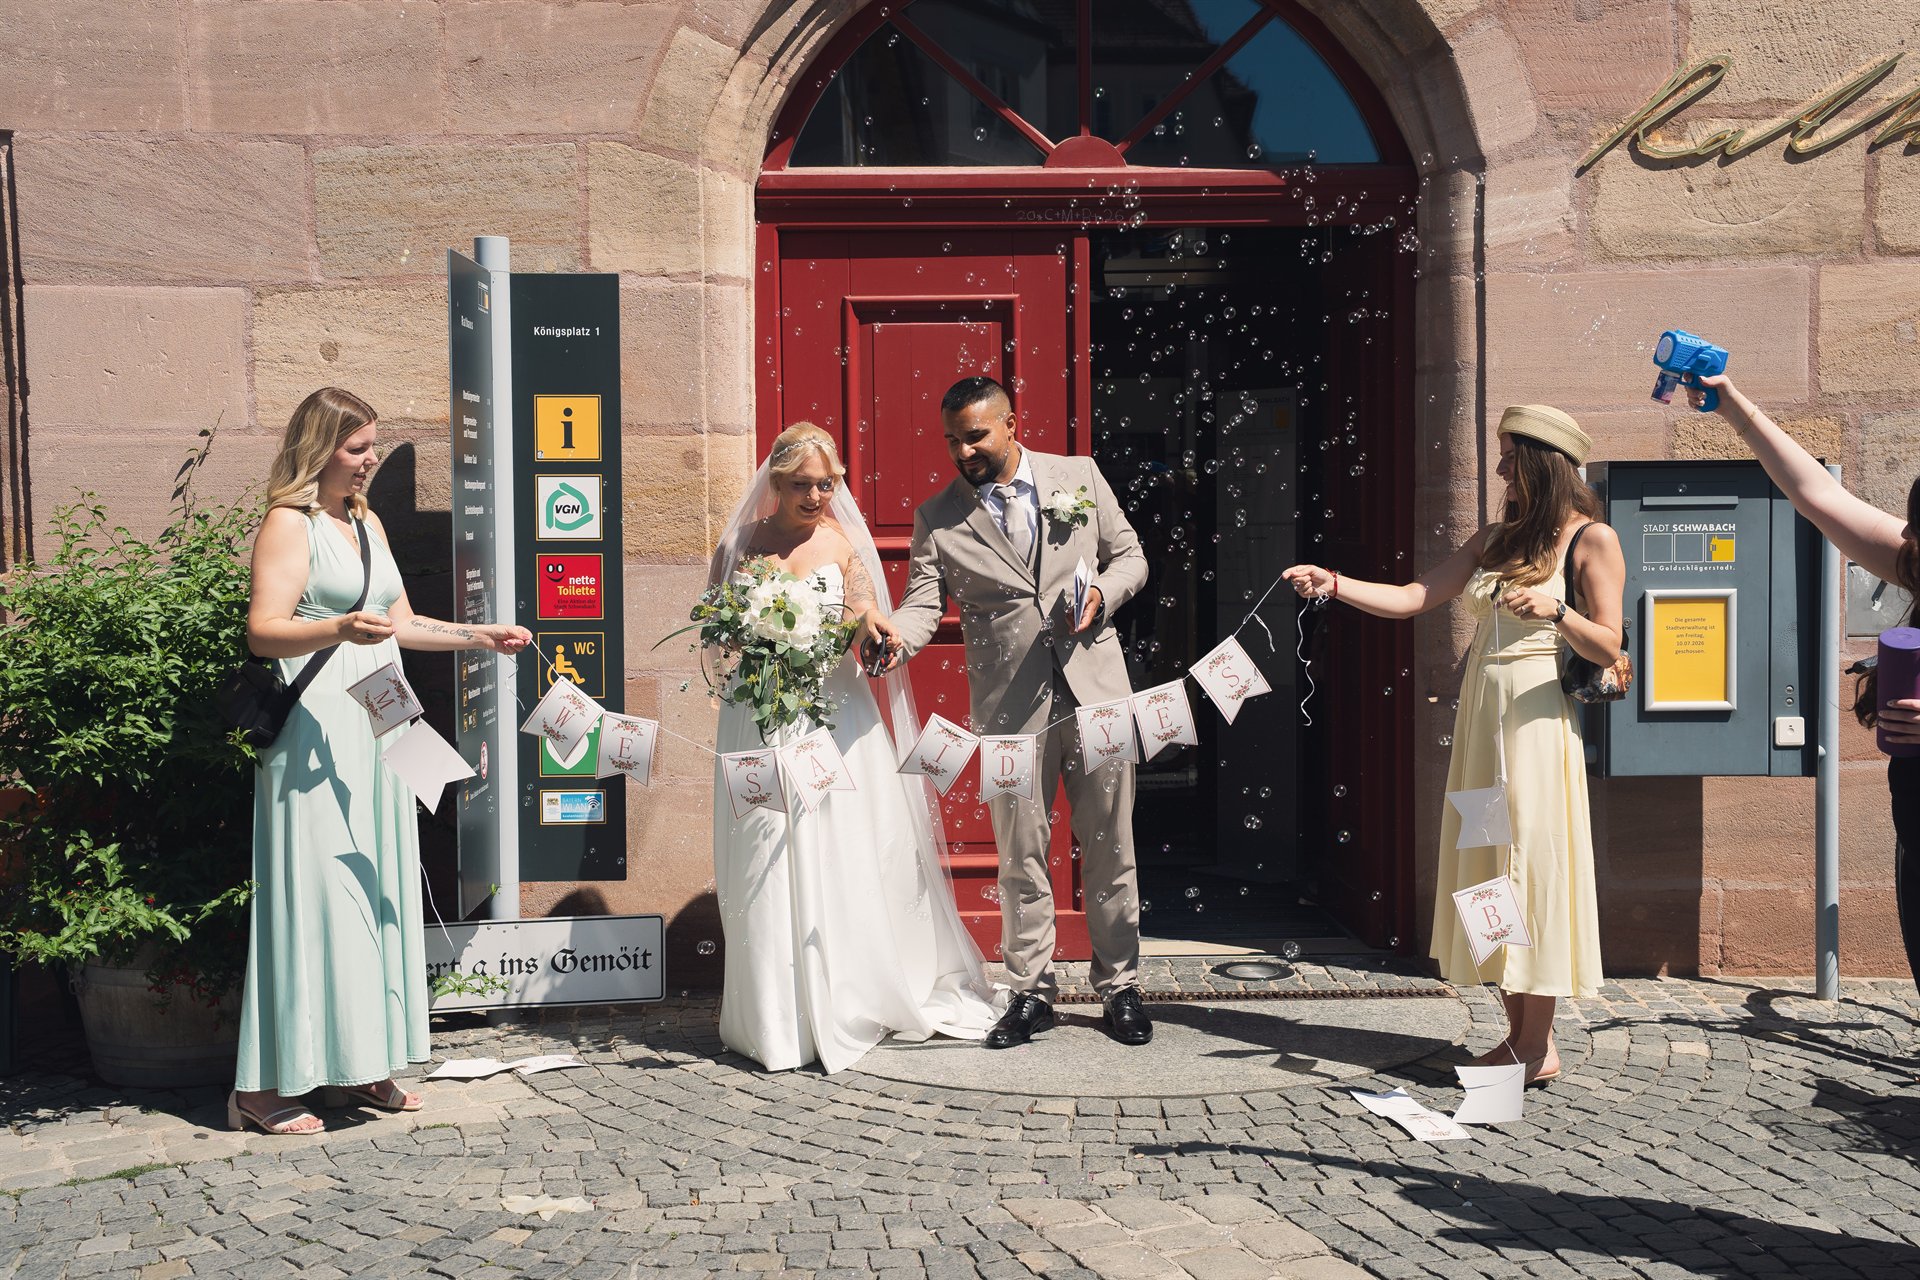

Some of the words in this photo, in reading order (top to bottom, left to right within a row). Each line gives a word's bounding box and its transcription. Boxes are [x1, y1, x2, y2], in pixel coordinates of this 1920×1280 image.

[533, 326, 591, 338] Königsplatz
[595, 326, 600, 336] 1
[555, 504, 580, 514] VGN
[1643, 524, 1669, 533] STADT
[1672, 523, 1736, 532] SCHWABACH
[1659, 564, 1736, 572] Goldschlägerstadt.
[569, 575, 596, 585] nette
[557, 586, 596, 595] Toilette
[574, 641, 595, 655] WC
[562, 803, 587, 811] WLAN
[1482, 904, 1502, 930] B
[426, 957, 462, 978] ert
[499, 952, 539, 976] ins
[551, 945, 653, 974] Gemöit
